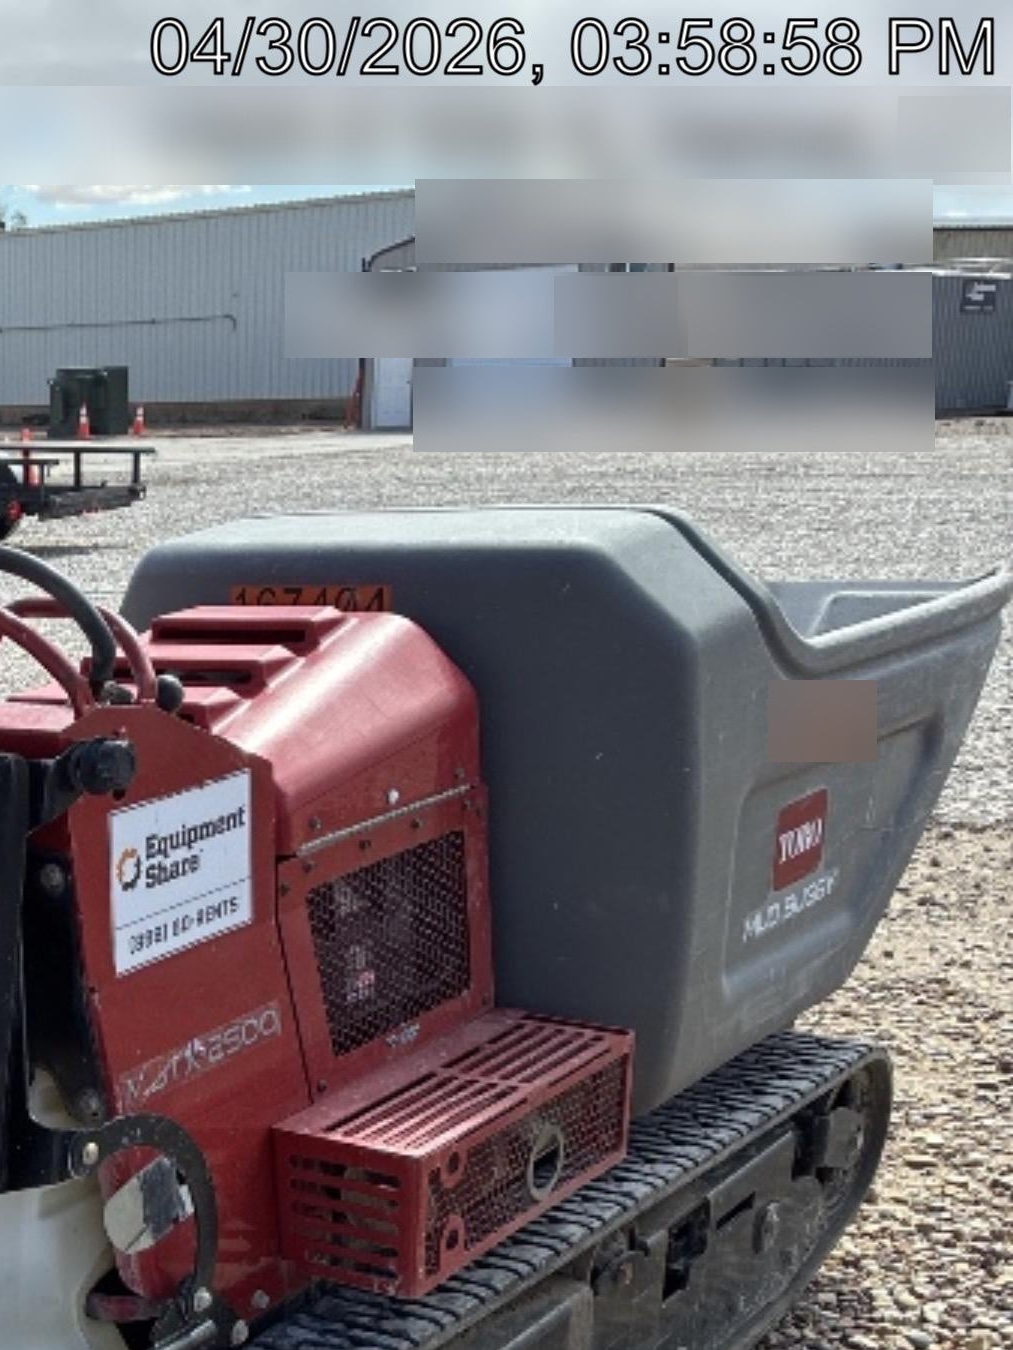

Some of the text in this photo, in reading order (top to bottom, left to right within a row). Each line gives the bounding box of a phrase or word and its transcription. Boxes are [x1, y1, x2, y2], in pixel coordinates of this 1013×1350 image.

[145, 806, 246, 861] Equipment
[145, 853, 201, 889] Share
[743, 902, 780, 943] MUD
